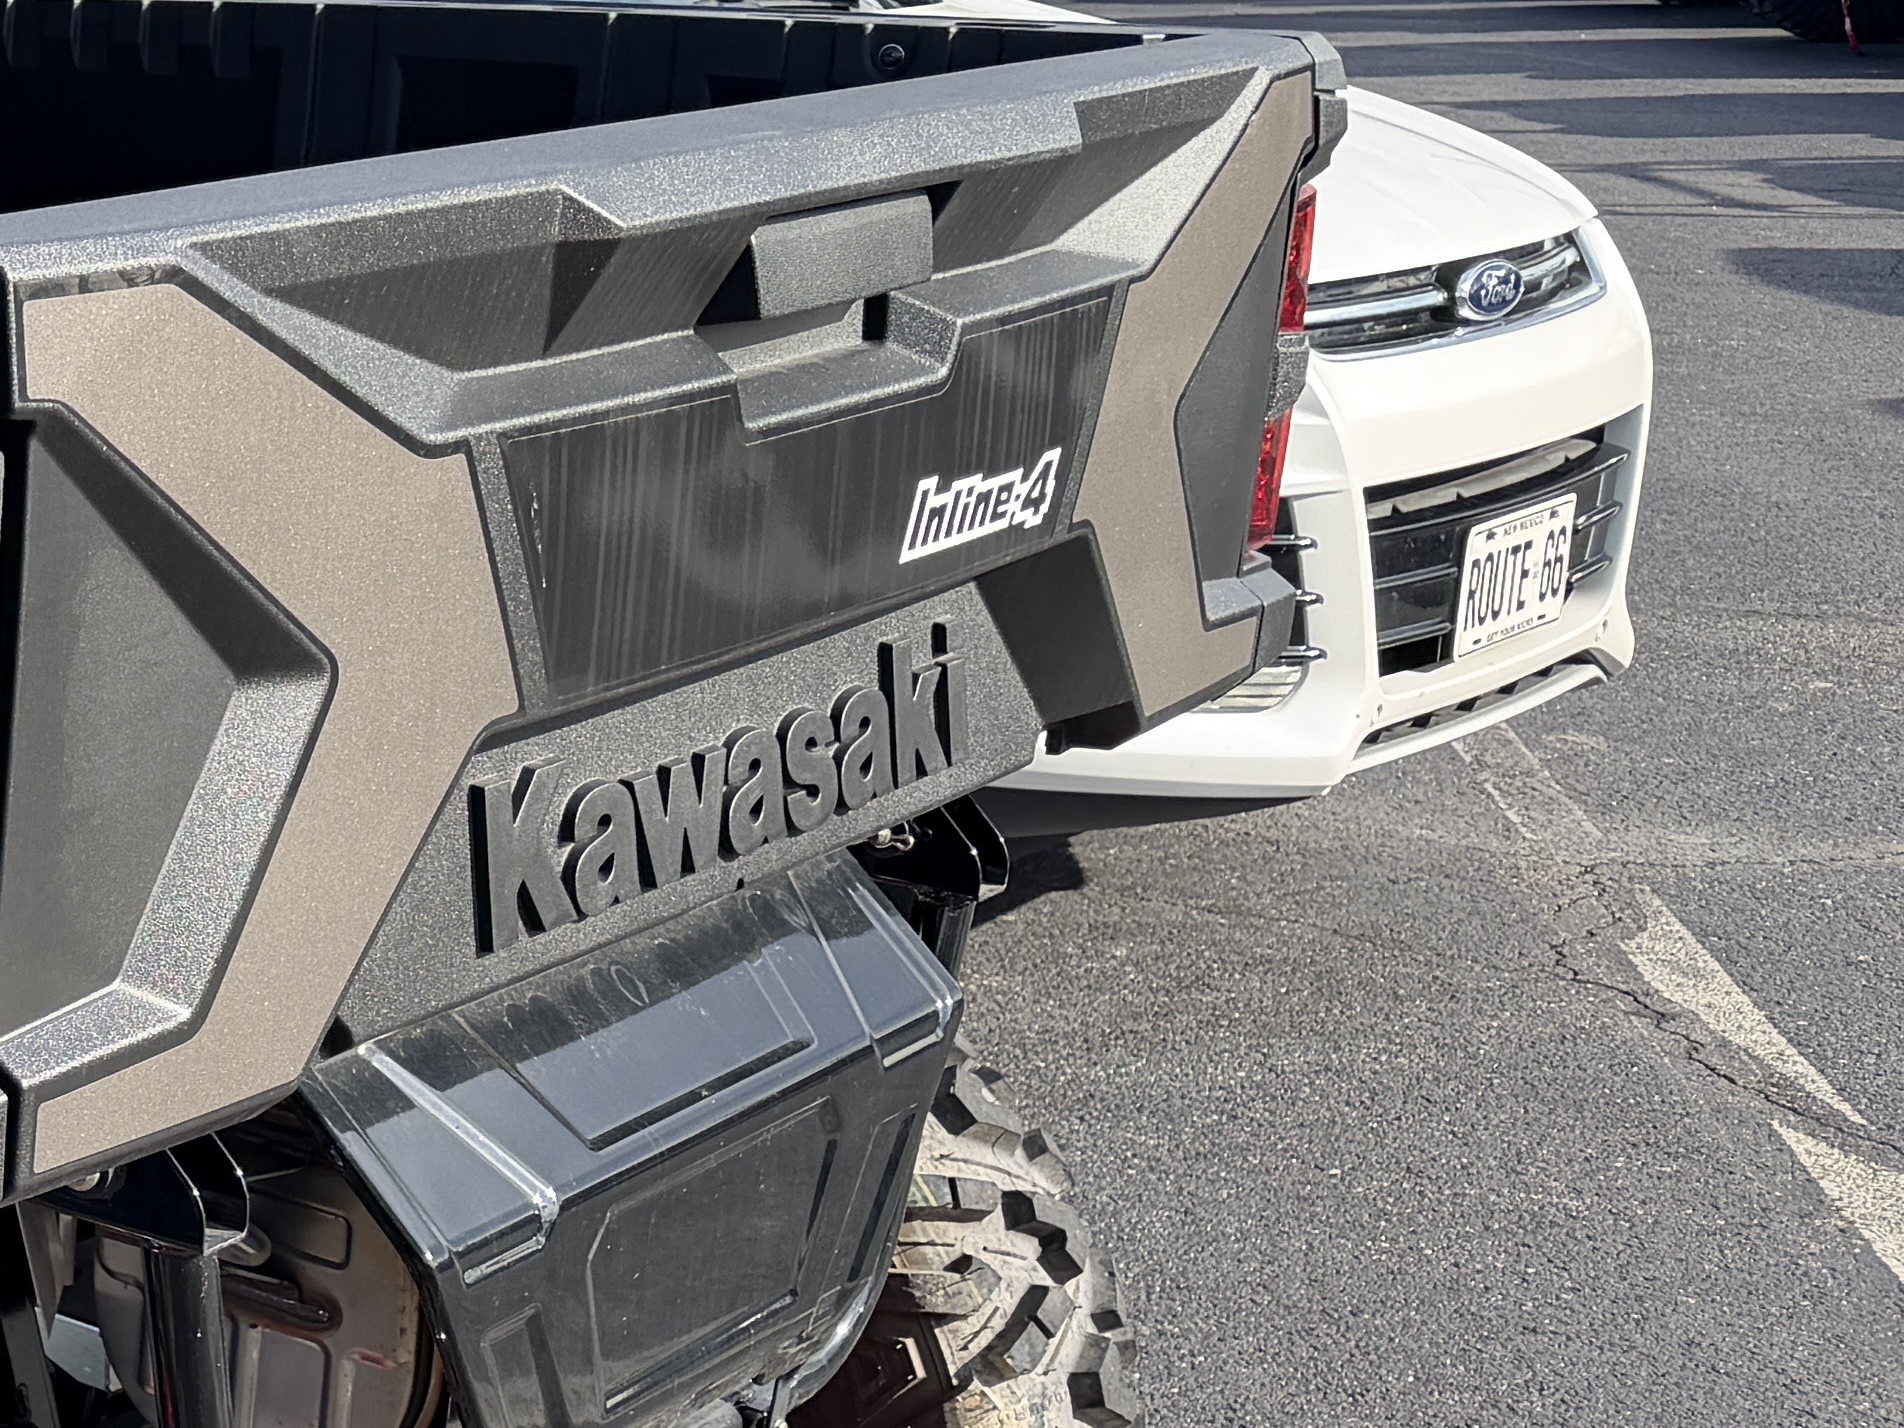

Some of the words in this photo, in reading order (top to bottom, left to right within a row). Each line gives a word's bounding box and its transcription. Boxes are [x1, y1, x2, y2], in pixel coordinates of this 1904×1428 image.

[1480, 268, 1516, 307] Ford
[899, 447, 1062, 564] Inline-4
[1463, 538, 1534, 633] ROUTE
[1538, 524, 1568, 603] 66
[468, 621, 969, 958] Kawasaki
